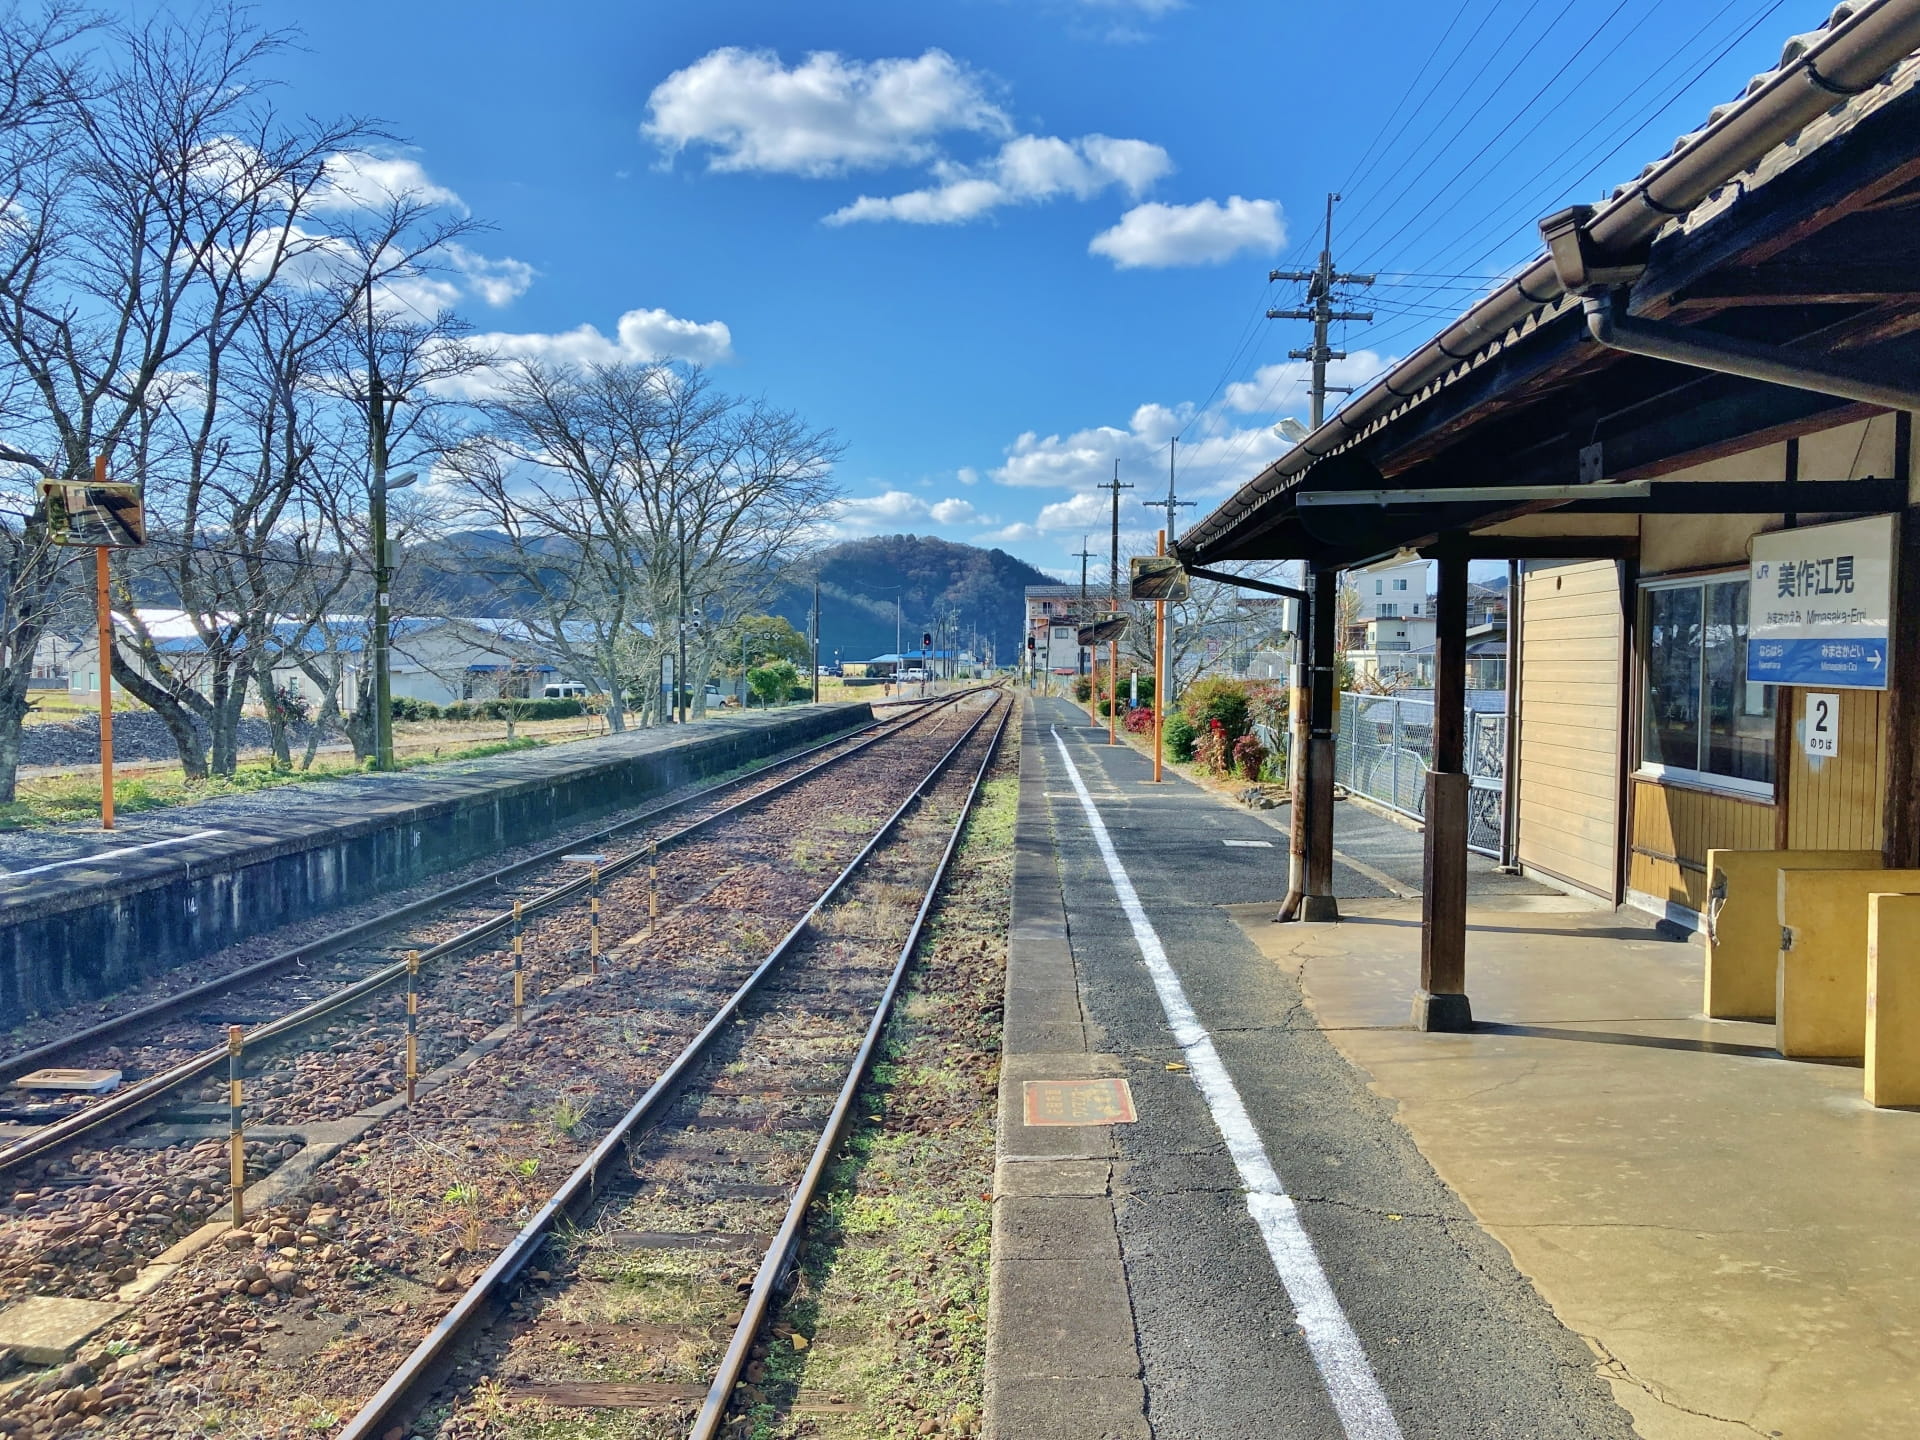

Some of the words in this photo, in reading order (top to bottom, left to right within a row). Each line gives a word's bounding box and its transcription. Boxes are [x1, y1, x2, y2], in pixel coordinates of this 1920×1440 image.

[1757, 564, 1769, 579] JR
[1778, 555, 1855, 598] 美作江見
[1807, 608, 1866, 624] Mimasaka-Emi
[1821, 645, 1865, 658] みまさかどい
[1815, 700, 1828, 732] 2
[1810, 738, 1832, 750] のりば
